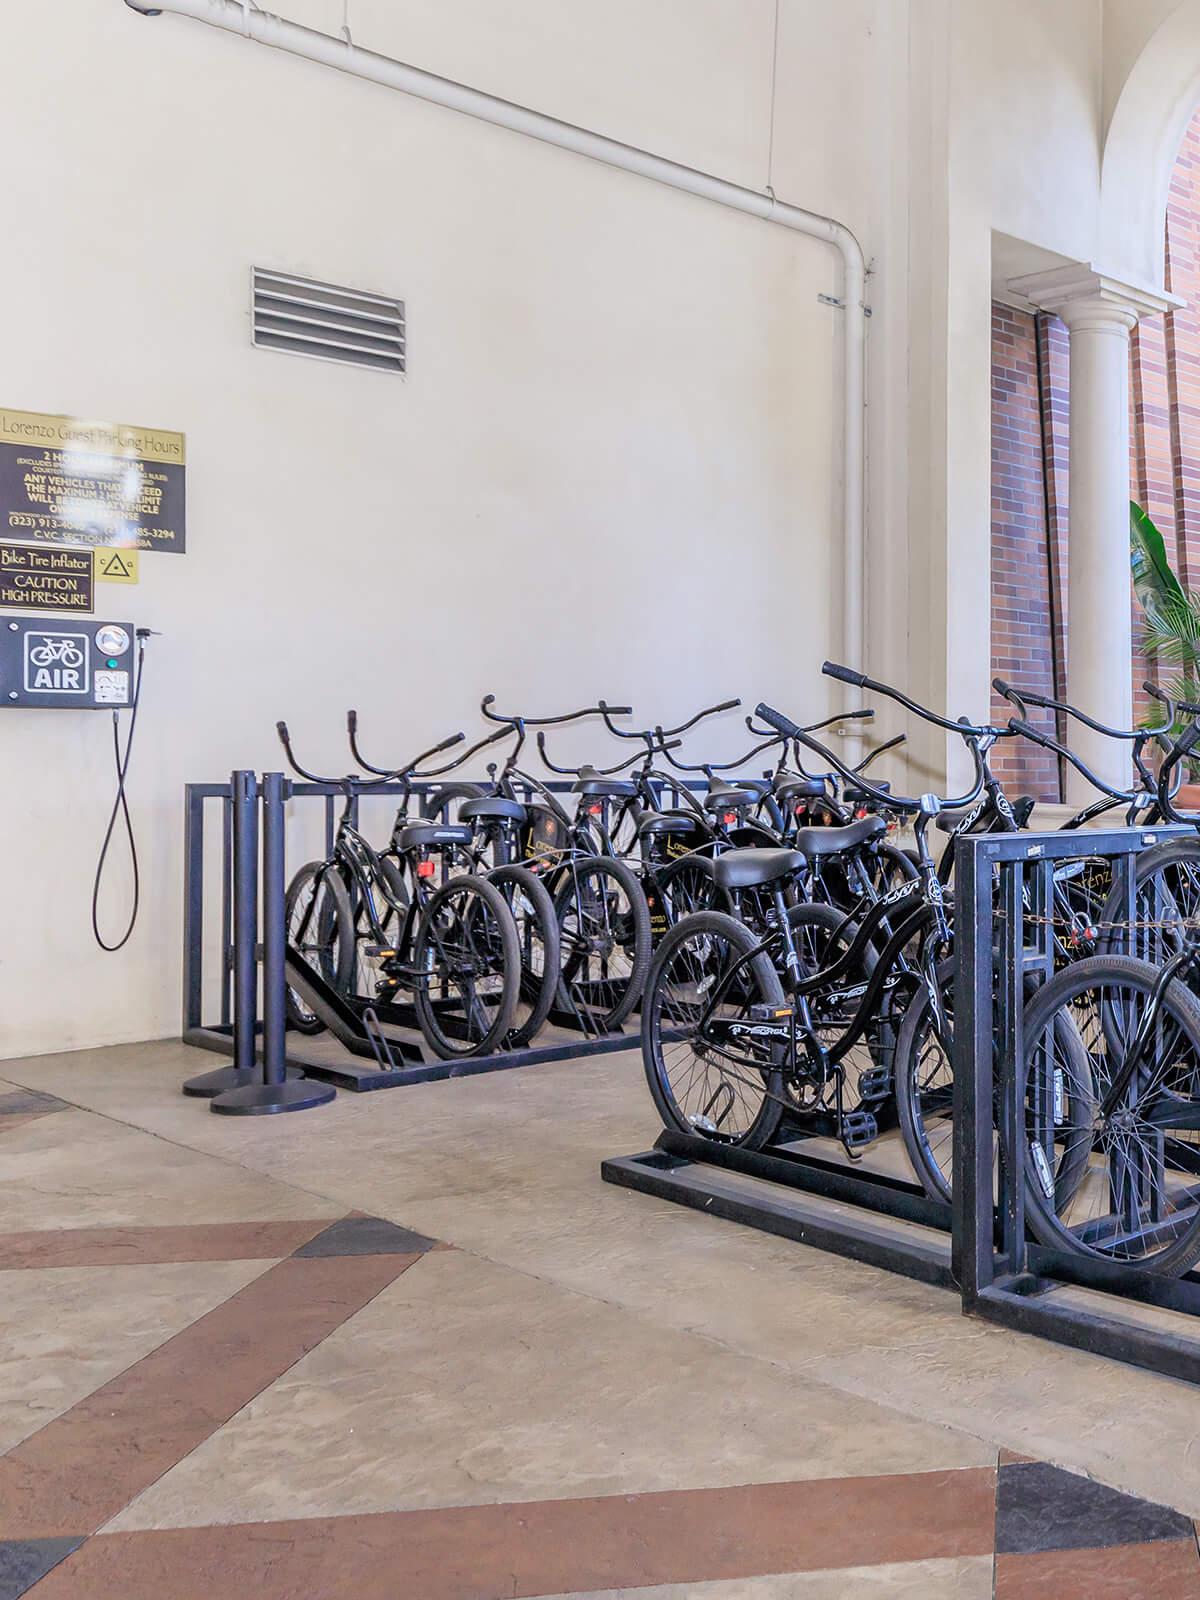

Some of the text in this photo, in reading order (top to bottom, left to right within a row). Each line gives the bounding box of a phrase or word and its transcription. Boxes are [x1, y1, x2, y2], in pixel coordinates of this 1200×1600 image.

[3, 416, 55, 439] Lorenzo
[145, 435, 180, 455] Hours
[24, 473, 47, 484] ANY
[48, 475, 95, 489] VEHICLES
[25, 482, 46, 494] THE
[48, 486, 97, 498] MAXIMUM
[27, 492, 54, 504] WILL
[9, 515, 36, 529] (323)
[1, 549, 26, 566] Bike
[27, 552, 49, 567] Tire
[50, 553, 89, 569] Inflator
[14, 575, 78, 590] CAUTION
[2, 589, 89, 606] HIGH PRESSURE
[34, 668, 80, 689] AIR
